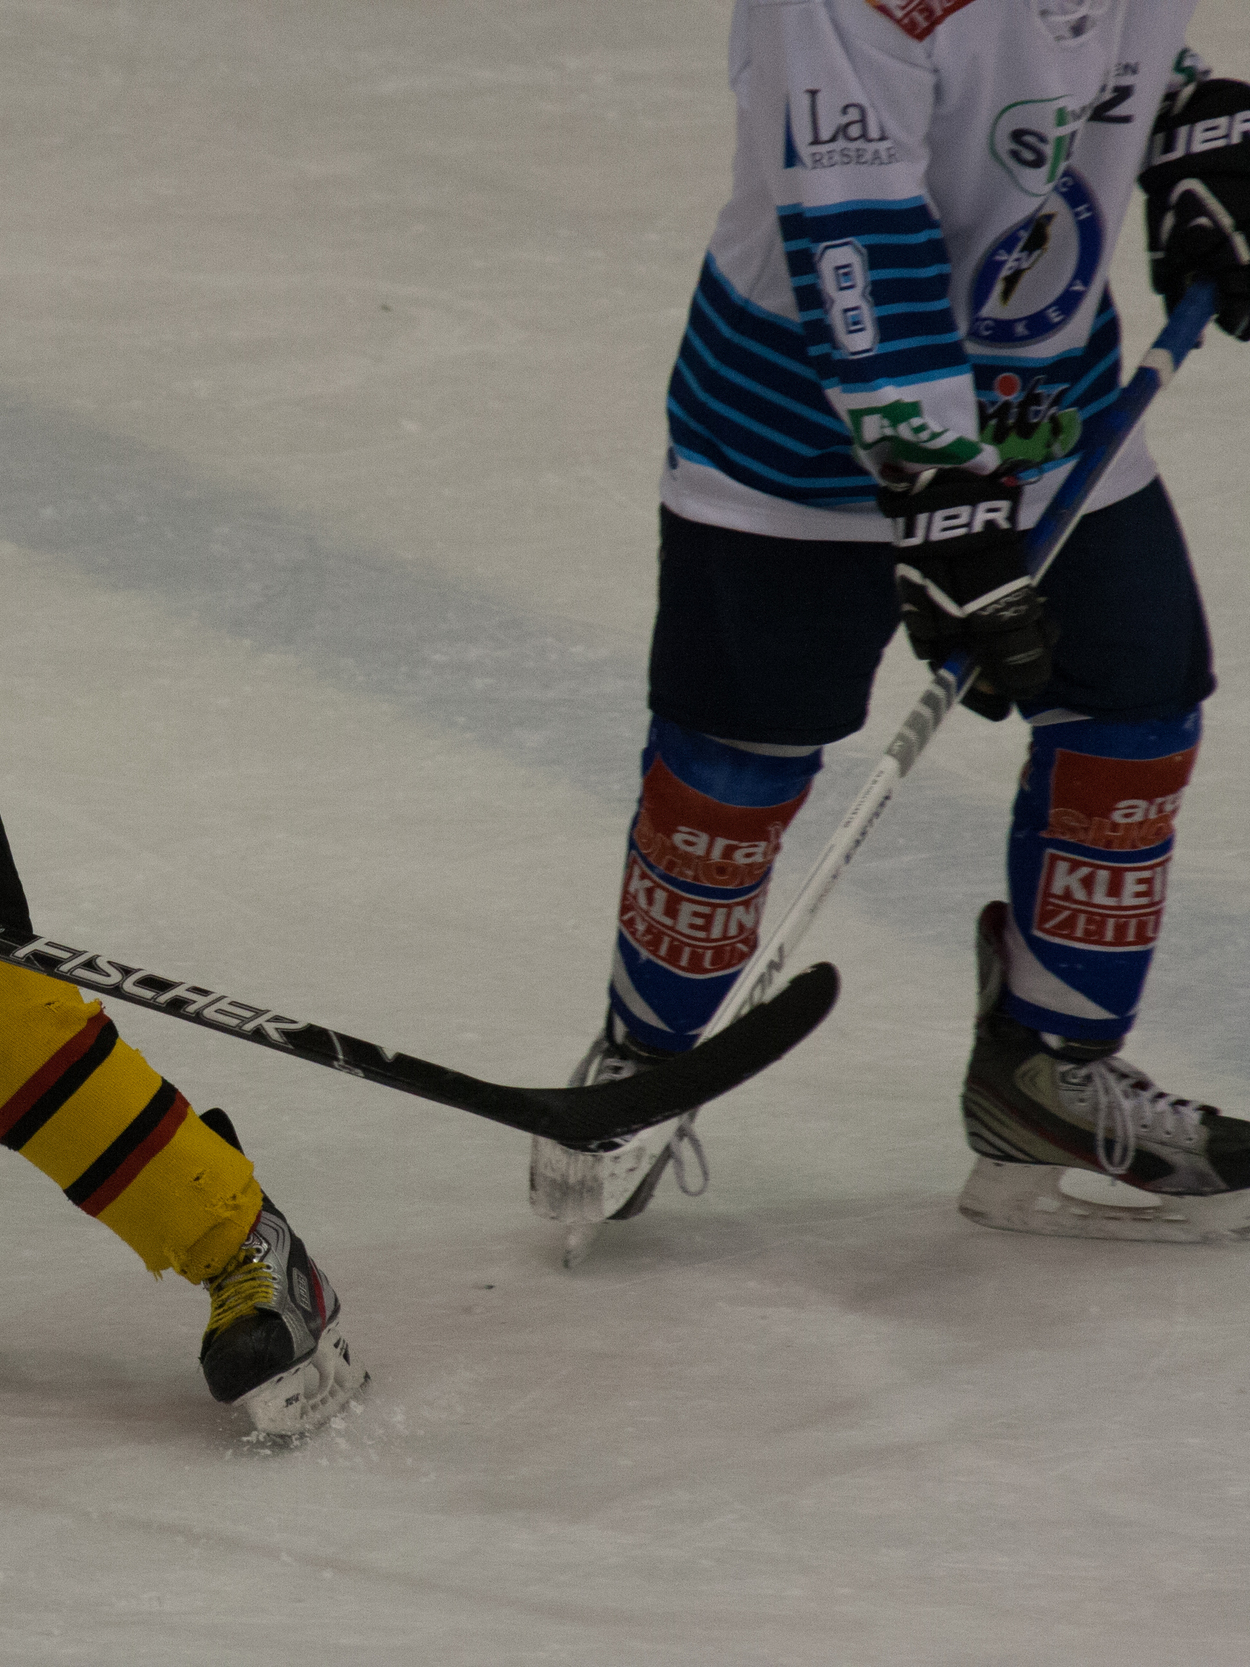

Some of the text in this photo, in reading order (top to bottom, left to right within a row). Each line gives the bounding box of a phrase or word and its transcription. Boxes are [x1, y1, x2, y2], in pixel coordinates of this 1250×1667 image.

[672, 825, 768, 865] ara
[629, 863, 758, 941] KLEIN
[10, 936, 312, 1049] FISCHER
